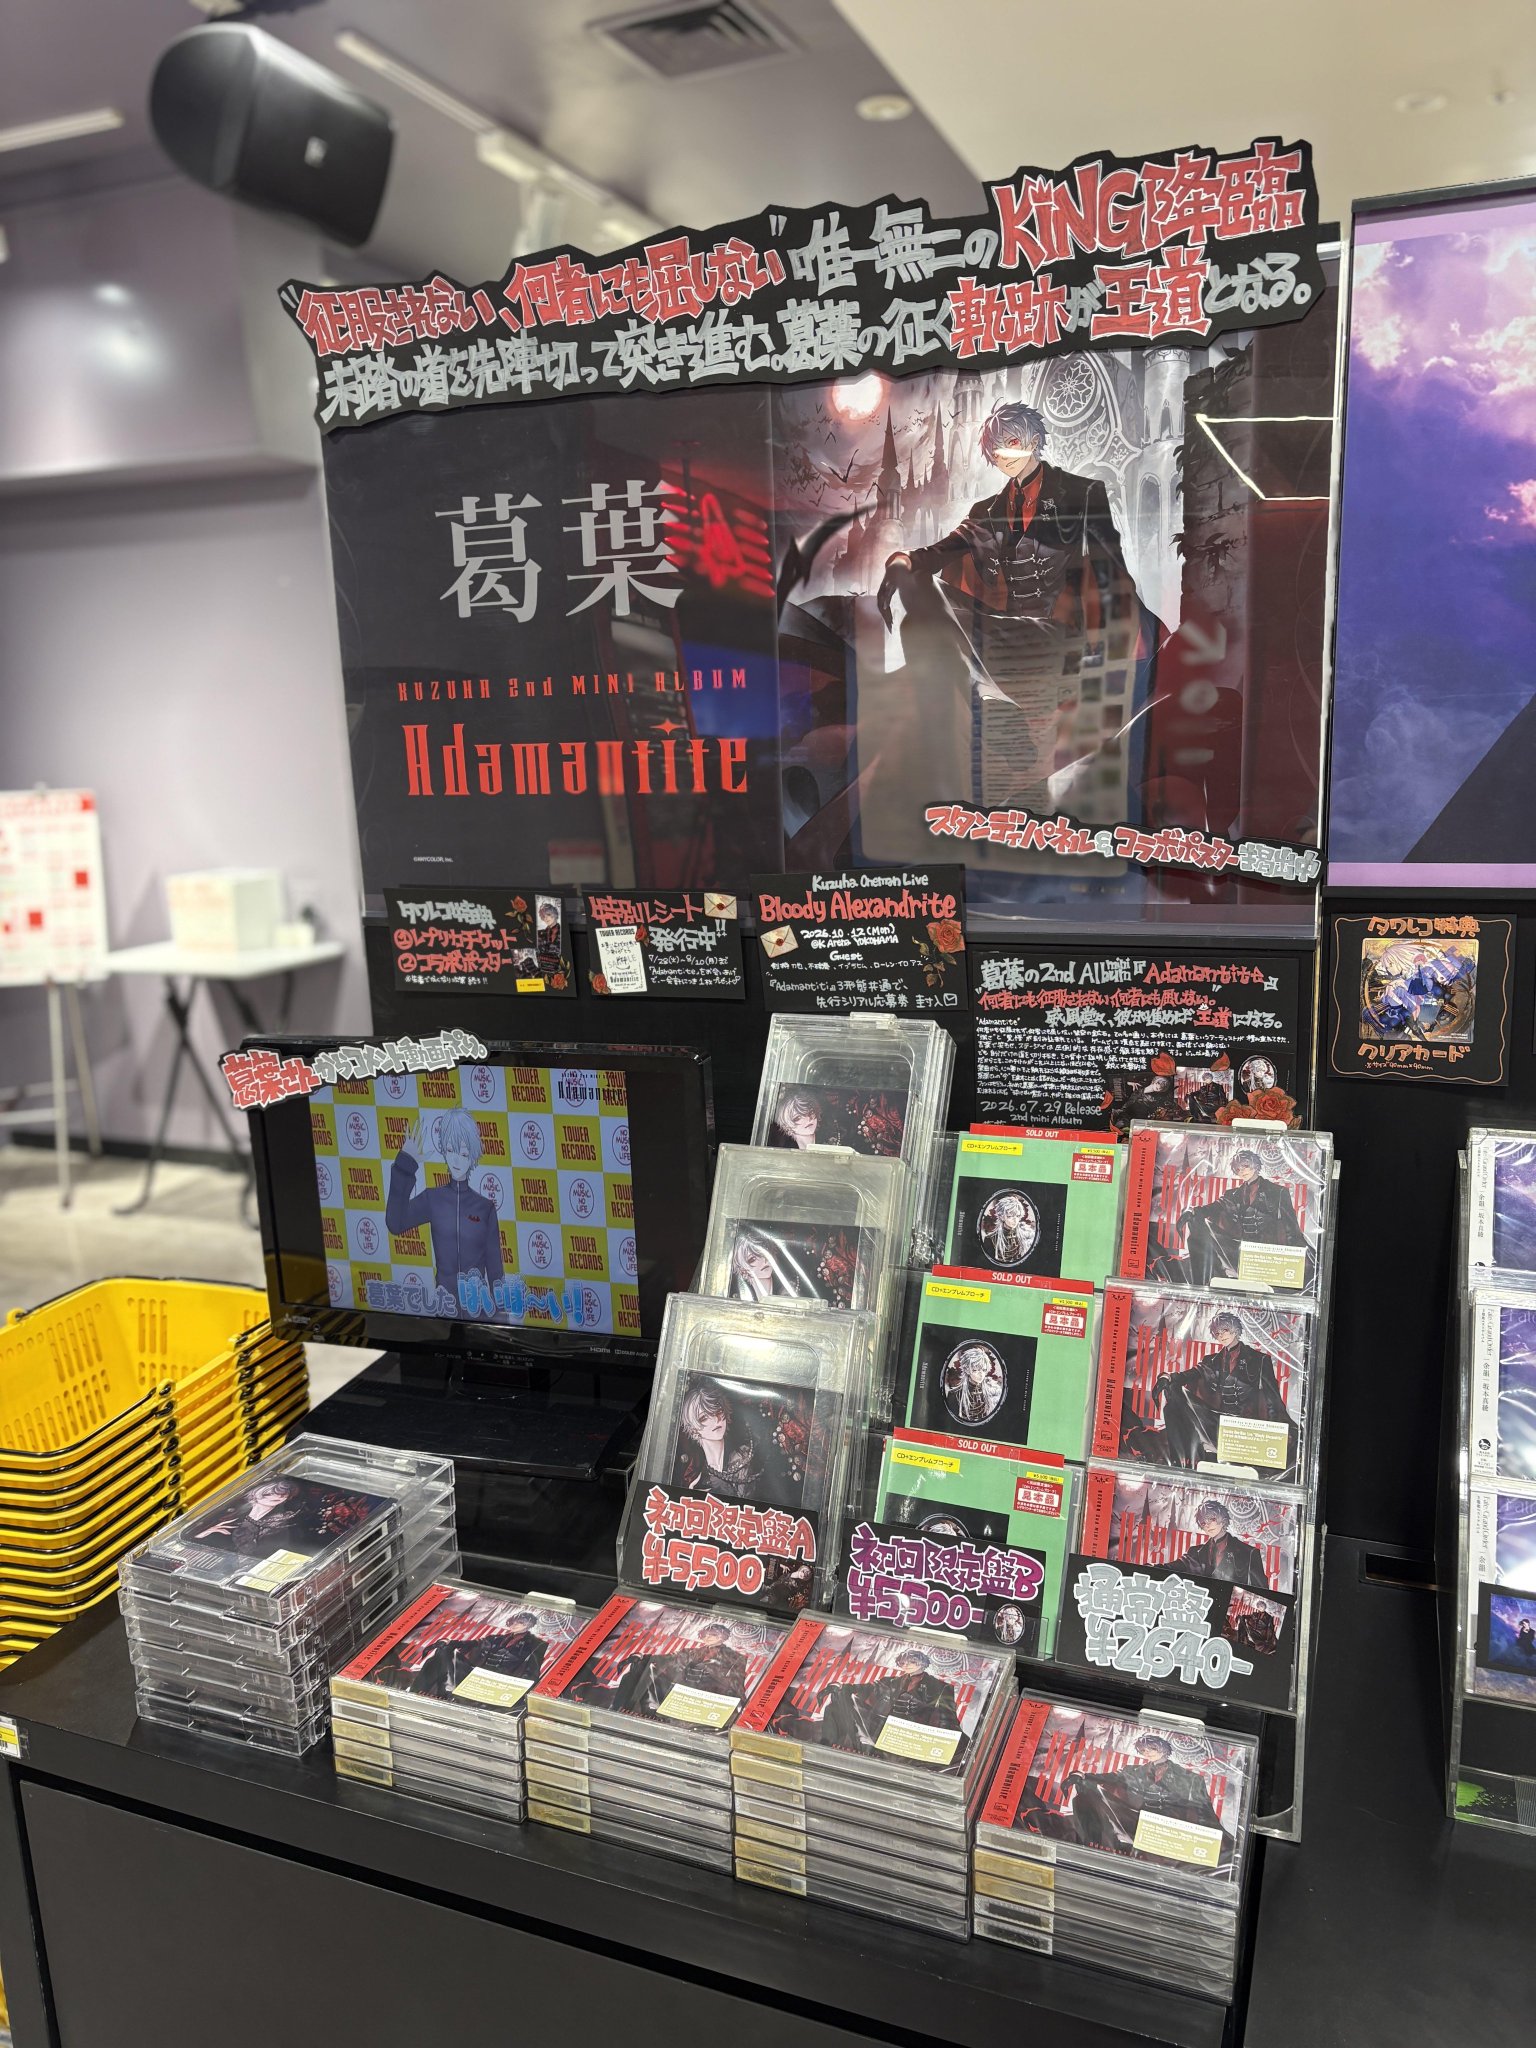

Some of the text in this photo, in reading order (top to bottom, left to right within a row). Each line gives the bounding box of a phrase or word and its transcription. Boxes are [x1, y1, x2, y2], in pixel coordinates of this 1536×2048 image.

[434, 479, 684, 623] 葛葉
[397, 668, 747, 702] KUZUHA 2nd MINI ALBUM
[402, 719, 749, 797] Adamantite
[812, 873, 929, 892] Kuzuha Oneman Live
[396, 899, 497, 930] タワレコ特典
[588, 894, 704, 927] 特別レシート
[759, 889, 956, 923] Bloody Alexandrite
[1367, 915, 1480, 937] タワレコ特典
[826, 936, 851, 949] Arena
[854, 934, 899, 947] YOKOHAMA
[829, 950, 863, 962] Guest
[1078, 960, 1132, 985] Album
[1358, 1043, 1471, 1063] クリアカード
[513, 1068, 540, 1085] TOWER
[422, 1083, 456, 1099] RECORDS
[512, 1086, 547, 1103] RECORDS
[980, 1100, 1103, 1116] 2026.07.29 Release
[1010, 1112, 1083, 1125] 2nd mini Album
[562, 1126, 590, 1143] TOWER
[1025, 1129, 1059, 1138] SOLD OUT
[561, 1144, 597, 1161] RECORDS
[348, 1168, 373, 1184] TOWER
[1077, 1163, 1107, 1174] 見本品
[347, 1185, 380, 1201] RECORDS
[521, 1179, 548, 1196] TOWER
[520, 1196, 554, 1213] RECORDS
[394, 1240, 427, 1257] RECORDS
[570, 1235, 597, 1253] TOWER
[569, 1254, 604, 1271] RECORDS
[992, 1272, 1032, 1285] SOLD OUT
[366, 1281, 458, 1318] 葛葉でした
[1048, 1315, 1080, 1327] 見本品
[958, 1439, 997, 1453] SOLD OUT
[1020, 1489, 1055, 1506] 見本品
[643, 1485, 816, 1561] 初回限定盤A
[642, 1530, 766, 1595] ¥5,500
[849, 1522, 1045, 1600] 初回限定盤B
[1074, 1563, 1213, 1639] 通常盤
